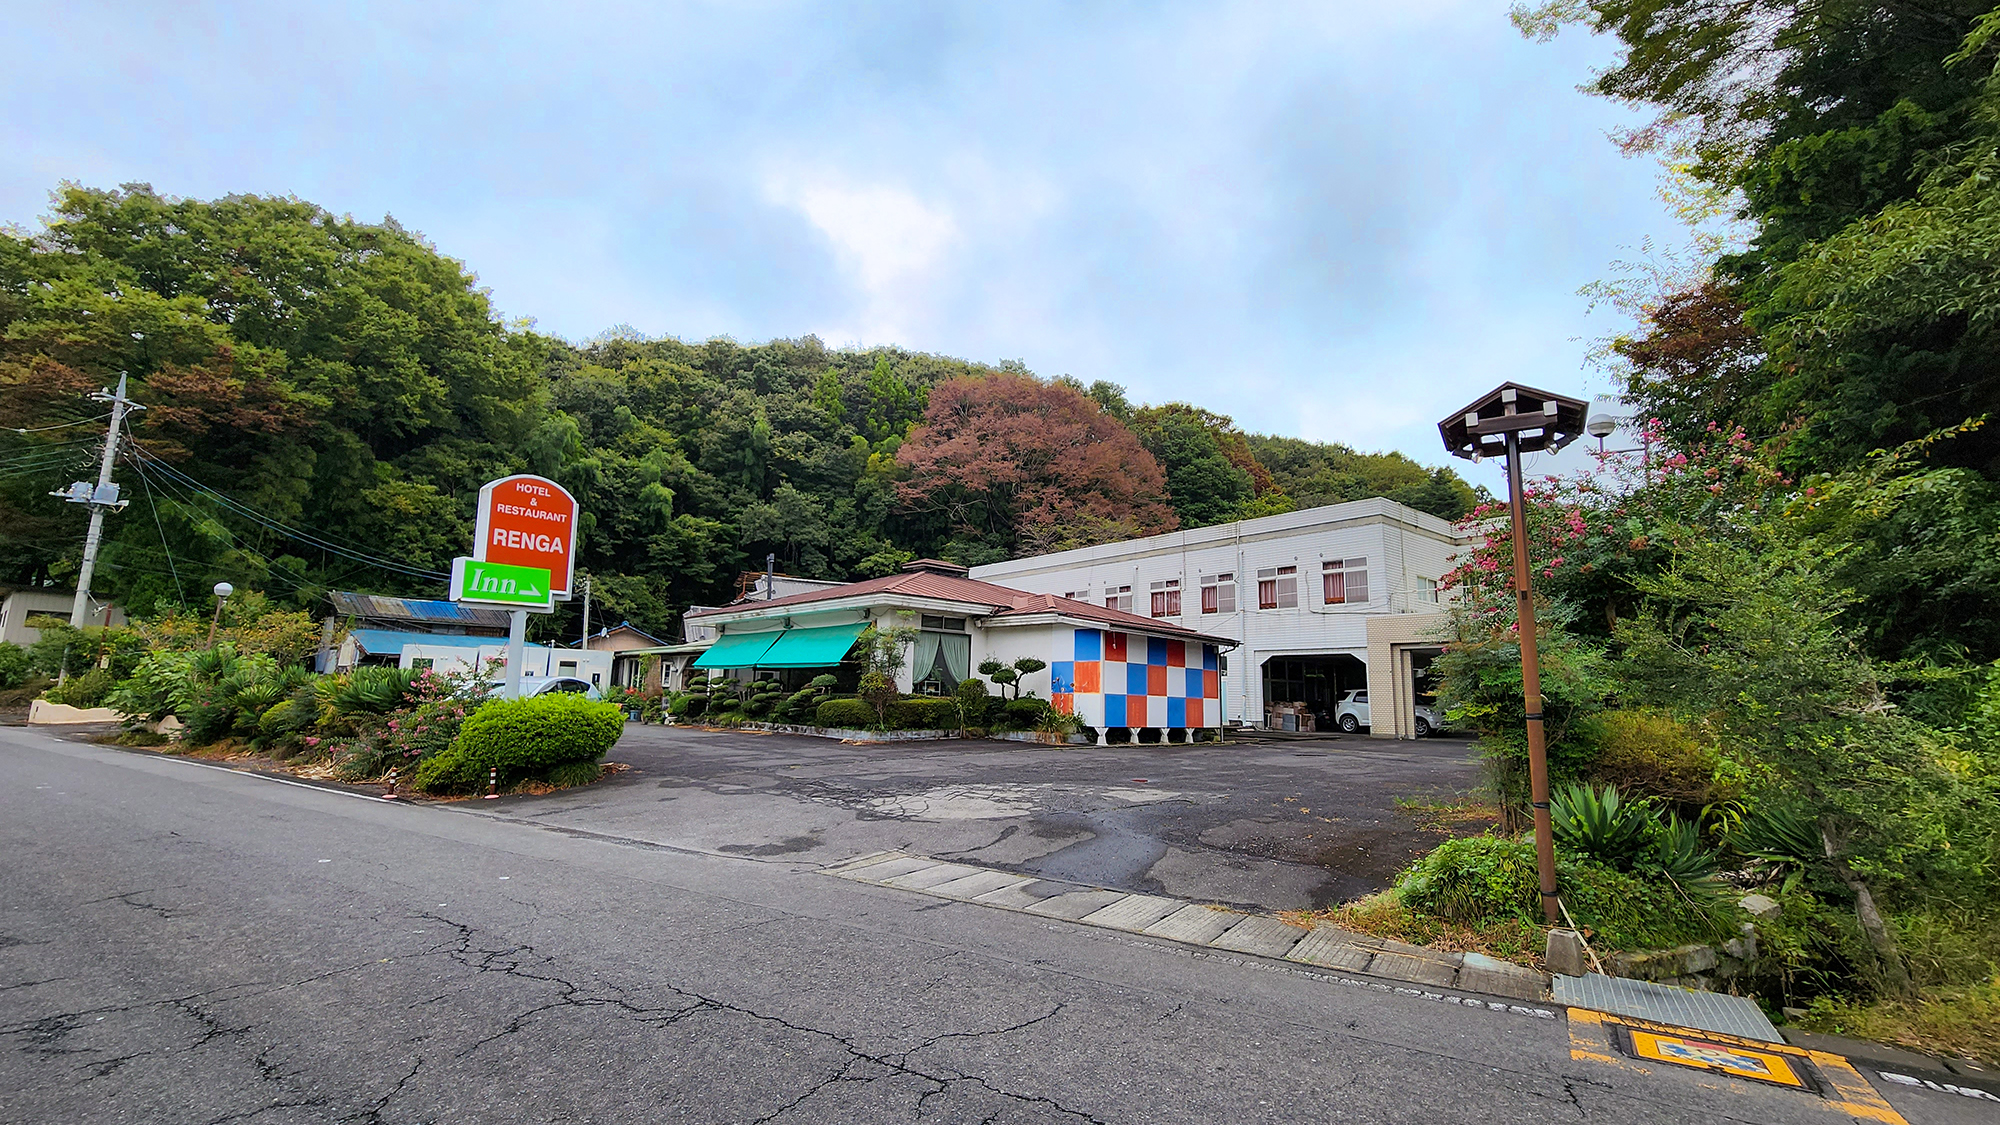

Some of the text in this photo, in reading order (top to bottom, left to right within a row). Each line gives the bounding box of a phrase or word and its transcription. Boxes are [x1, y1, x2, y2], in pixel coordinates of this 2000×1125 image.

[516, 482, 551, 497] HOTEL
[530, 497, 538, 506] &
[496, 503, 567, 522] RESTAURANT
[493, 528, 564, 554] RENGA
[468, 568, 517, 595] Inn
